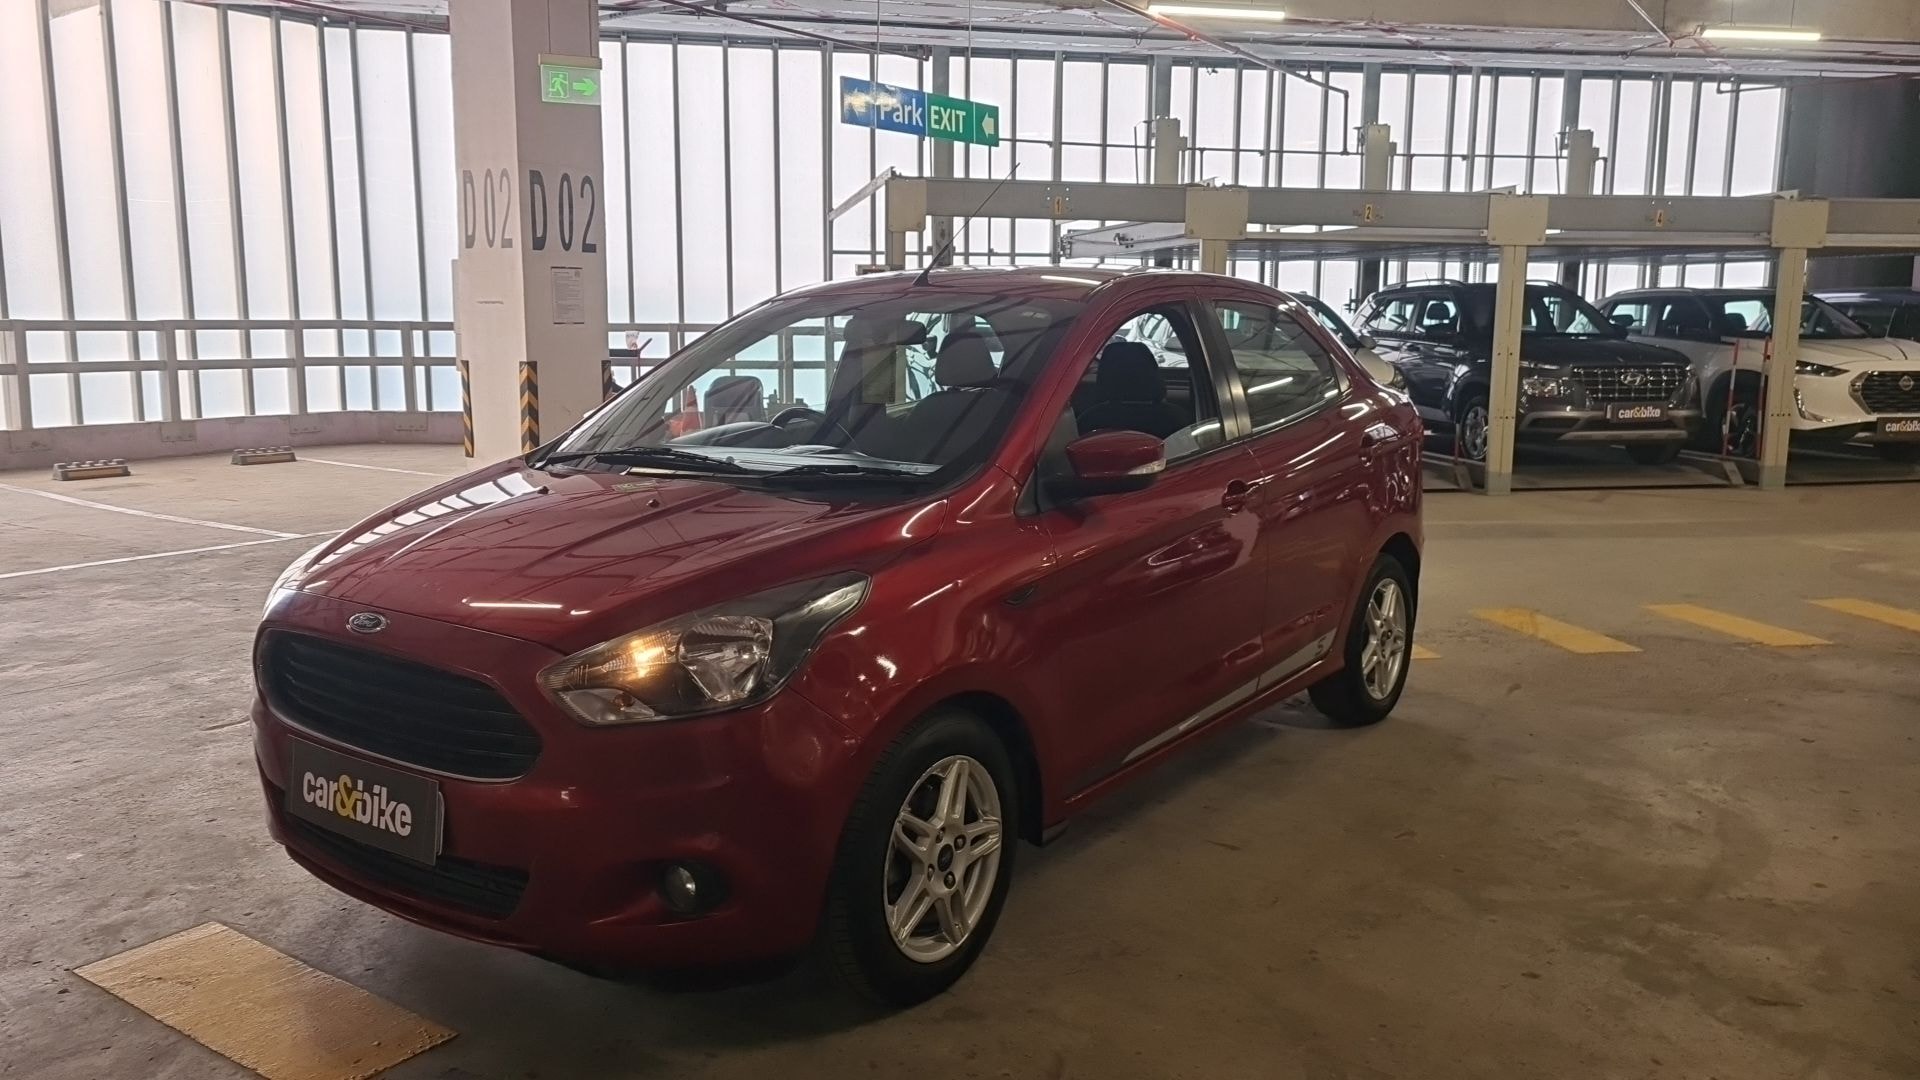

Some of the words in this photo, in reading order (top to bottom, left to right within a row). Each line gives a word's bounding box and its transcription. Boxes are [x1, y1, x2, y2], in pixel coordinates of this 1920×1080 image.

[880, 97, 924, 127] Park
[930, 105, 966, 133] EXIT
[1618, 405, 1661, 418] car&bike
[303, 771, 412, 837] car&bike
